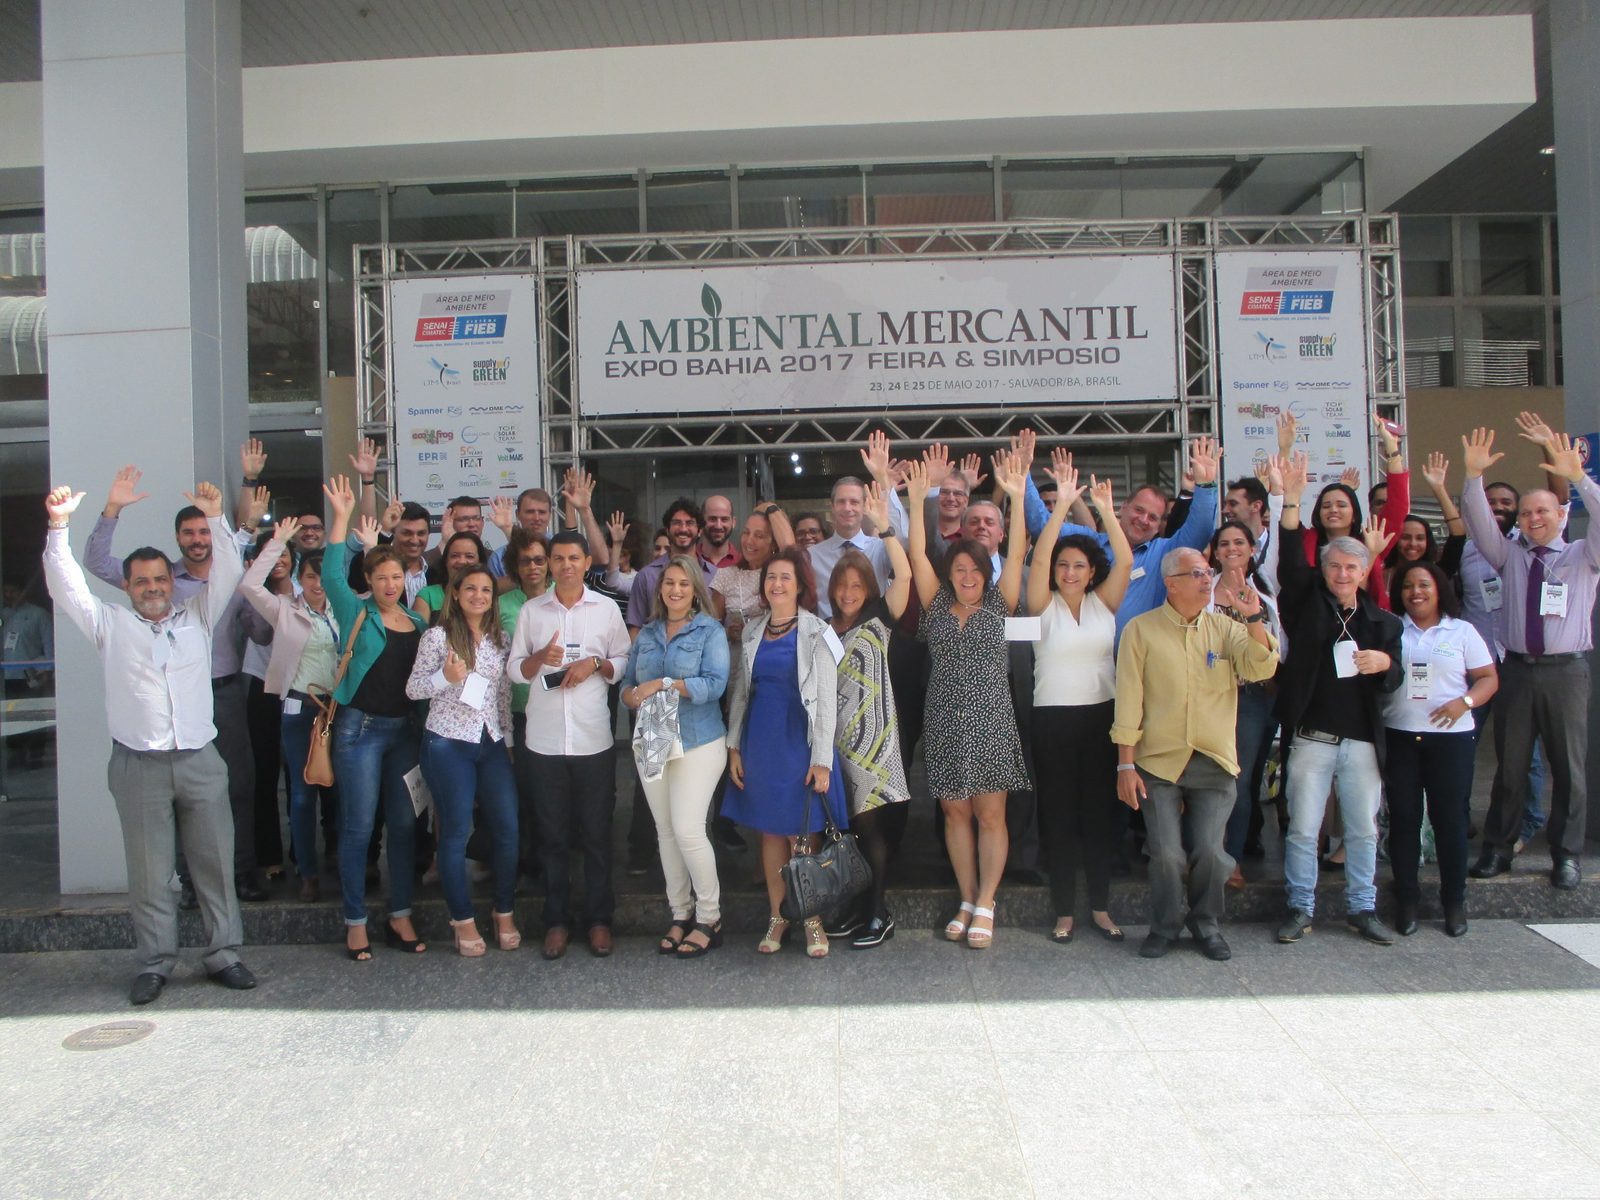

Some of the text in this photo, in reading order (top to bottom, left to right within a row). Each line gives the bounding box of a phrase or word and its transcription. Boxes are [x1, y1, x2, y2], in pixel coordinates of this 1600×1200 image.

[1287, 270, 1299, 278] DE
[1301, 269, 1322, 277] MEIO
[461, 295, 473, 303] DE
[475, 293, 496, 302] MEIO
[445, 303, 487, 312] AMBIENTE
[1290, 298, 1323, 310] FIEB
[422, 321, 448, 331] SENAI
[464, 322, 497, 336] FIEB
[1299, 334, 1323, 345] supply
[1299, 344, 1333, 357] GREEN
[473, 358, 497, 368] supply
[604, 347, 1121, 379] EXPO BAHIA 2017 FEIRA & SIMPOSIO
[473, 368, 507, 382] GREEN
[869, 382, 886, 392] 23,
[888, 382, 901, 391] 24
[904, 383, 910, 391] E
[912, 382, 926, 391] 25
[928, 382, 943, 390] DE
[944, 380, 973, 390] MAIO
[975, 379, 1000, 389] 2017
[1008, 377, 1083, 389] SALVADOR/BA,
[1086, 376, 1121, 386] BRASIL
[1233, 381, 1270, 391] Spanner
[408, 408, 443, 416] Spanner
[1244, 427, 1265, 435] EPR
[418, 452, 438, 461] EPR
